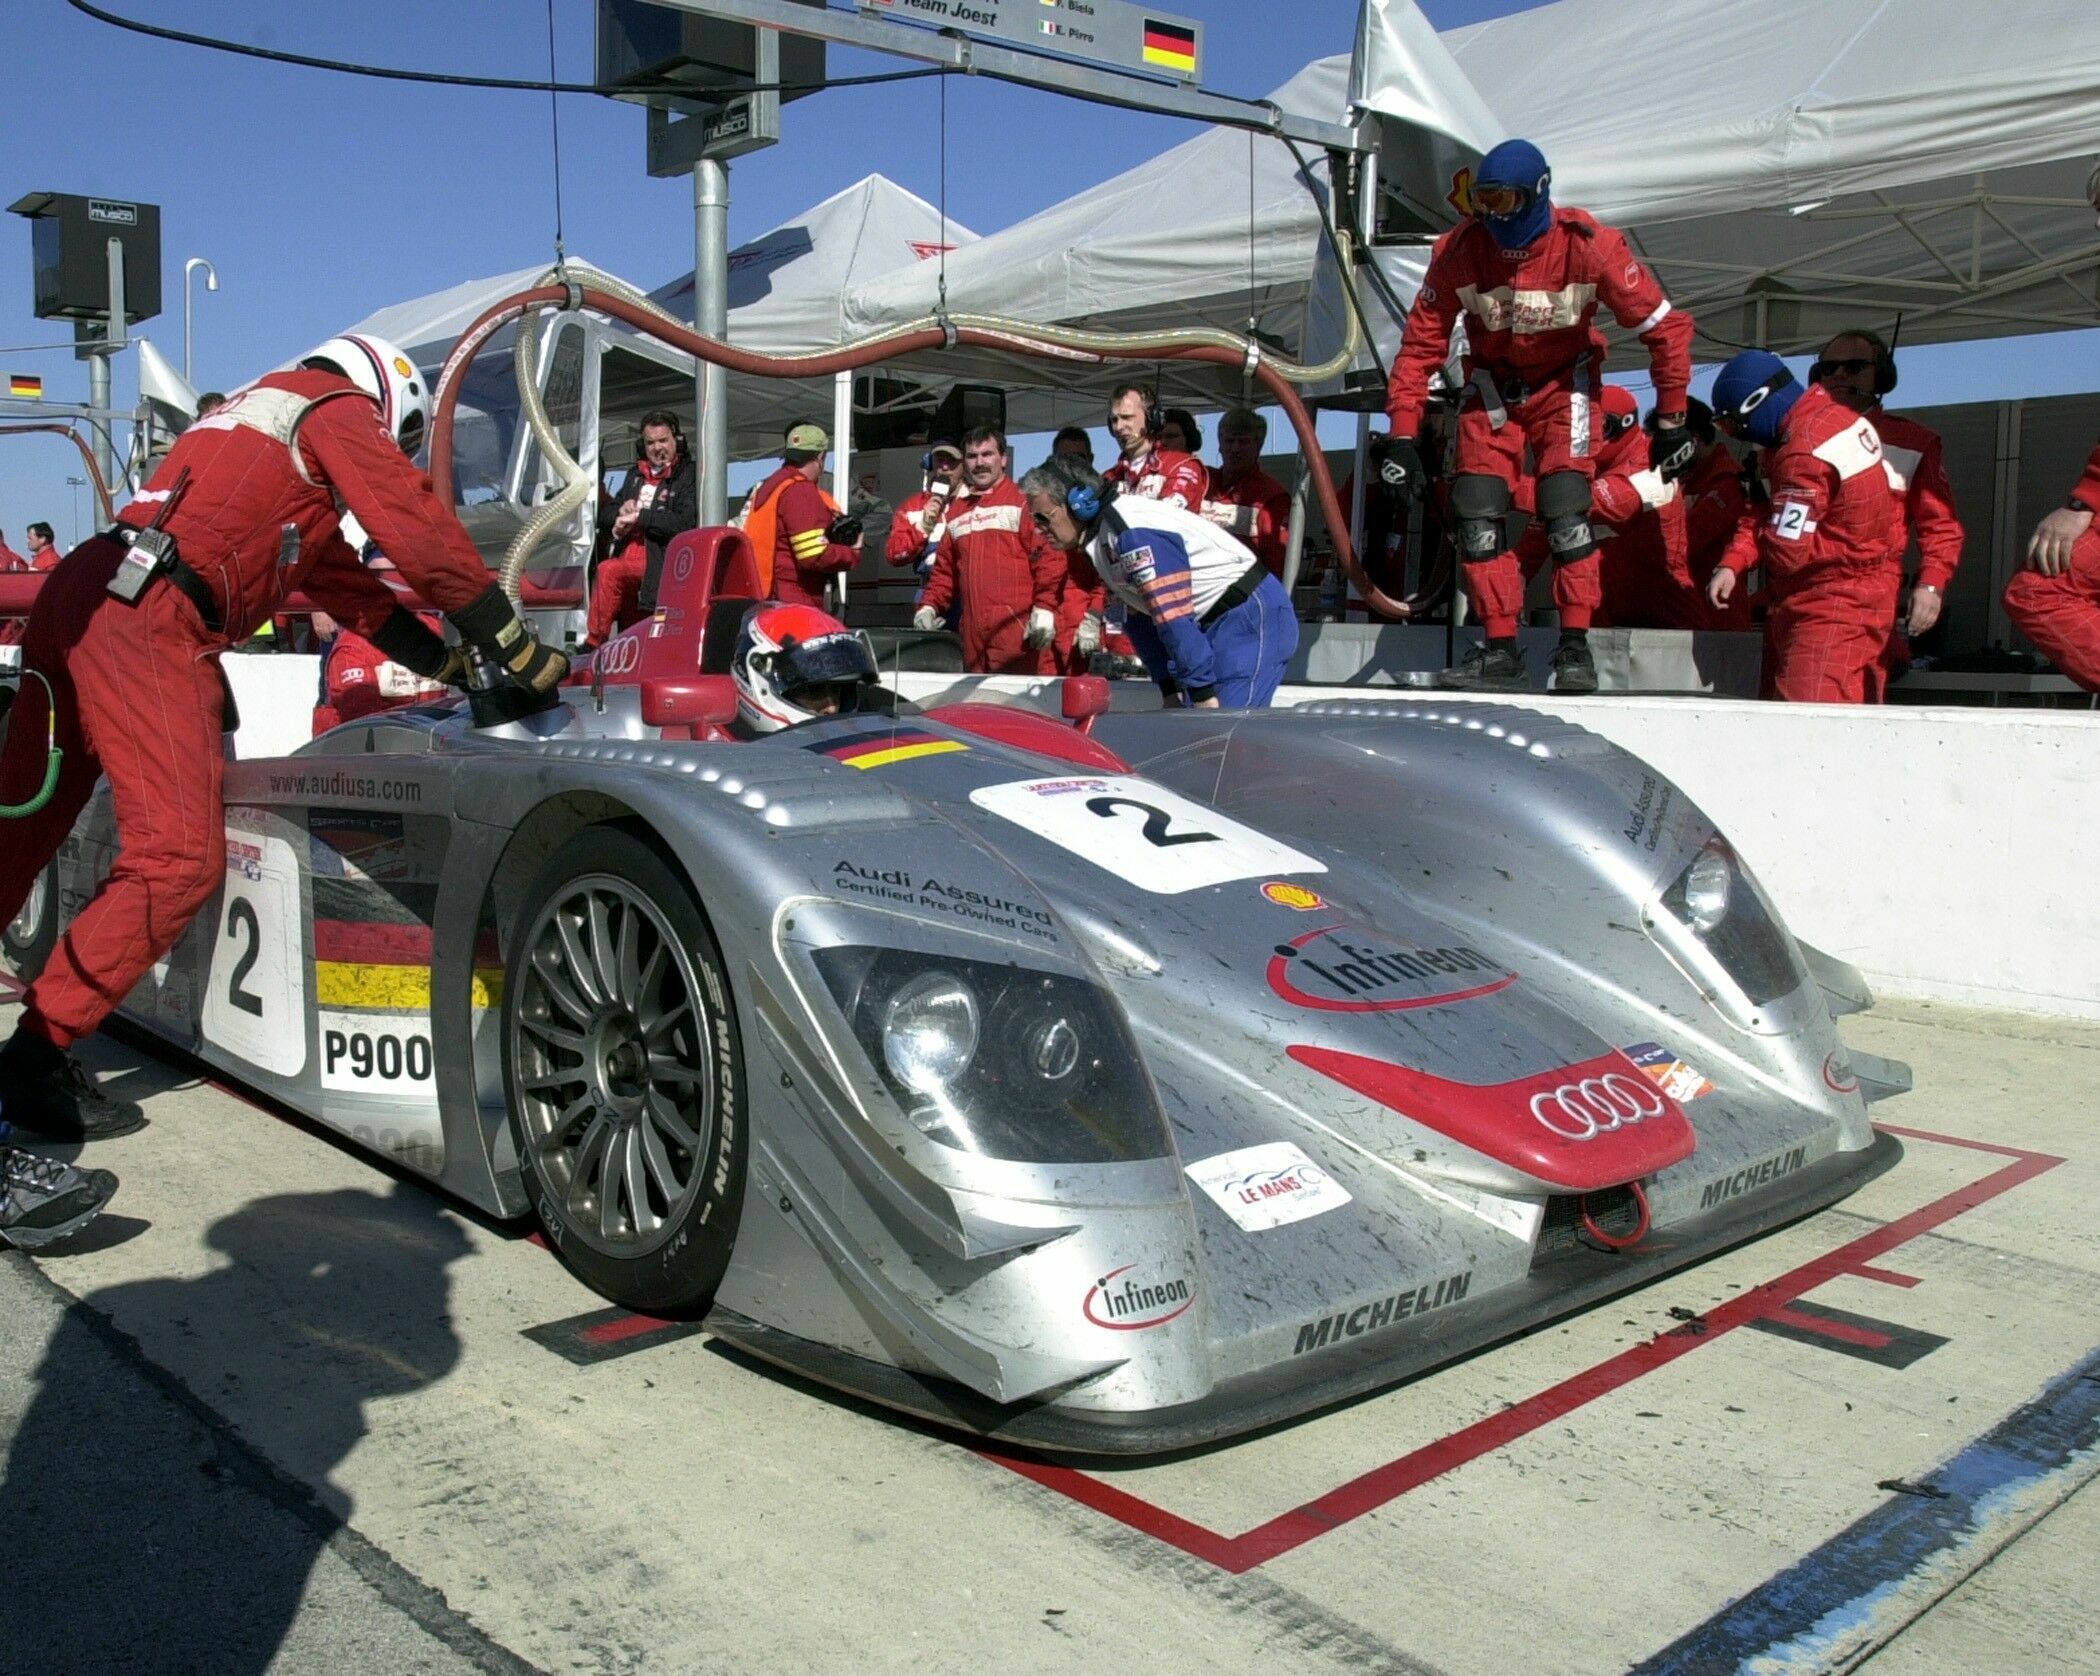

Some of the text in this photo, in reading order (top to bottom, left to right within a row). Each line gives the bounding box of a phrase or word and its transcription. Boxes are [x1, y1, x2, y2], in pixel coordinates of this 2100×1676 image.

[951, 2, 998, 27] Joest
[1069, 28, 1094, 43] Pirro
[1784, 508, 1802, 530] 2
[269, 772, 421, 801] www.audiusa.com
[1086, 797, 1224, 847] 2
[833, 860, 1053, 927] Audi Assured
[835, 878, 1058, 943] Certified Pre-Owned Cars
[227, 895, 264, 1017] 2
[1300, 944, 1505, 995] Infineon
[325, 1030, 432, 1081] P900
[713, 1018, 734, 1196] MICHELIN
[1238, 1175, 1303, 1205] LE MANS
[1700, 1145, 1806, 1210] MICHELIN
[1098, 1279, 1190, 1318] Infineon
[1293, 1271, 1473, 1356] MICHELIN
